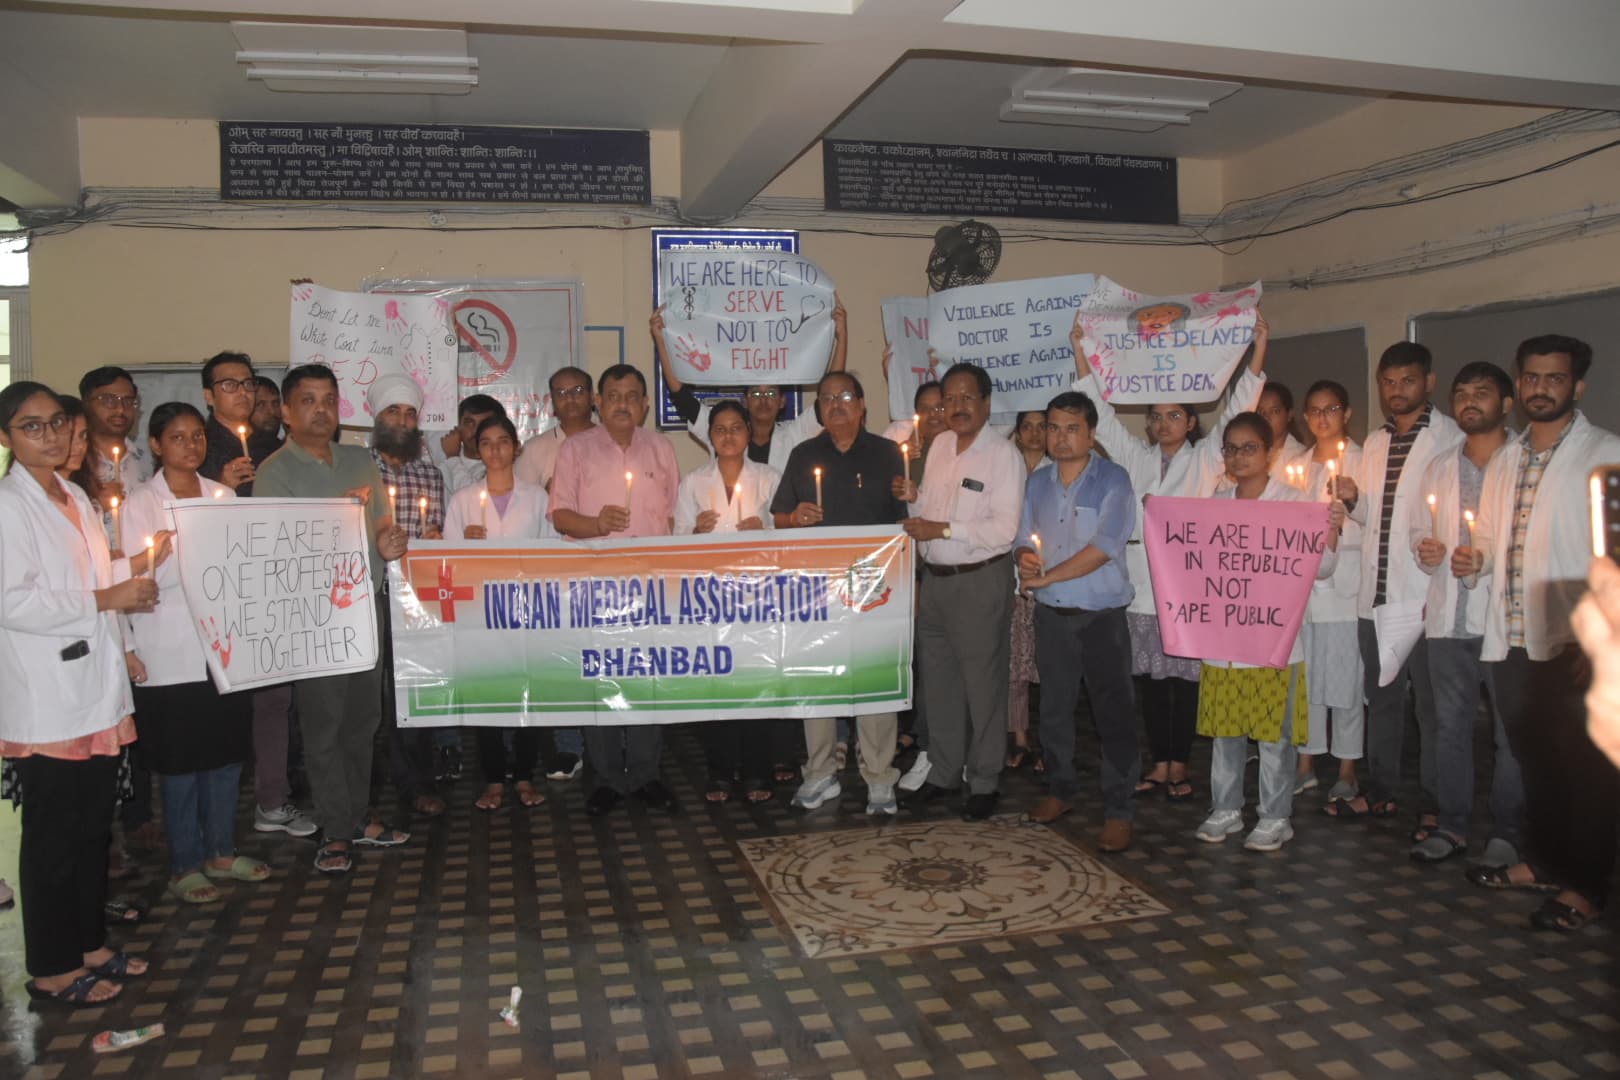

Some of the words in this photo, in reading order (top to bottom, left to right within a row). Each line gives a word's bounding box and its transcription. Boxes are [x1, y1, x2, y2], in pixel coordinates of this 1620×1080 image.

[252, 127, 266, 138] सह
[313, 128, 328, 140] सह
[382, 129, 398, 141] सह
[670, 261, 698, 287] WE
[702, 261, 735, 287] ARE
[741, 260, 789, 287] HERE
[796, 262, 818, 287] TO
[724, 290, 787, 313] SERVE
[944, 302, 1016, 322] VIOLENCE
[1025, 293, 1088, 314] AGAINS
[717, 320, 757, 343] NOT
[765, 319, 788, 343] TO
[958, 328, 1009, 347] DOCTOR
[1104, 332, 1167, 350] JUSTICE
[1173, 326, 1255, 348] DELAYED
[731, 347, 790, 370] FIGHT
[1152, 354, 1176, 371] IS
[1106, 374, 1175, 393] JUSTICE
[1181, 373, 1216, 392] DEN
[226, 521, 269, 560] WE
[273, 520, 324, 556] ARE
[1166, 521, 1197, 545] WE
[1209, 524, 1250, 549] ARE
[1262, 526, 1326, 554] LIVING
[1185, 550, 1203, 570] IN
[1218, 551, 1303, 577] REPUBLIC
[202, 562, 253, 602] ONE
[437, 588, 454, 600] Dr
[1205, 576, 1252, 599] NOT
[483, 580, 561, 629] INDIAN
[568, 576, 671, 629] MEDICAL
[679, 575, 829, 625] ASSOCIATION
[1165, 602, 1212, 624] APE
[1225, 603, 1284, 628] PUBLIC
[224, 601, 258, 639] WE
[264, 594, 332, 633] STAND
[247, 626, 362, 674] TOGETHER
[582, 645, 733, 678] DHANBAD
